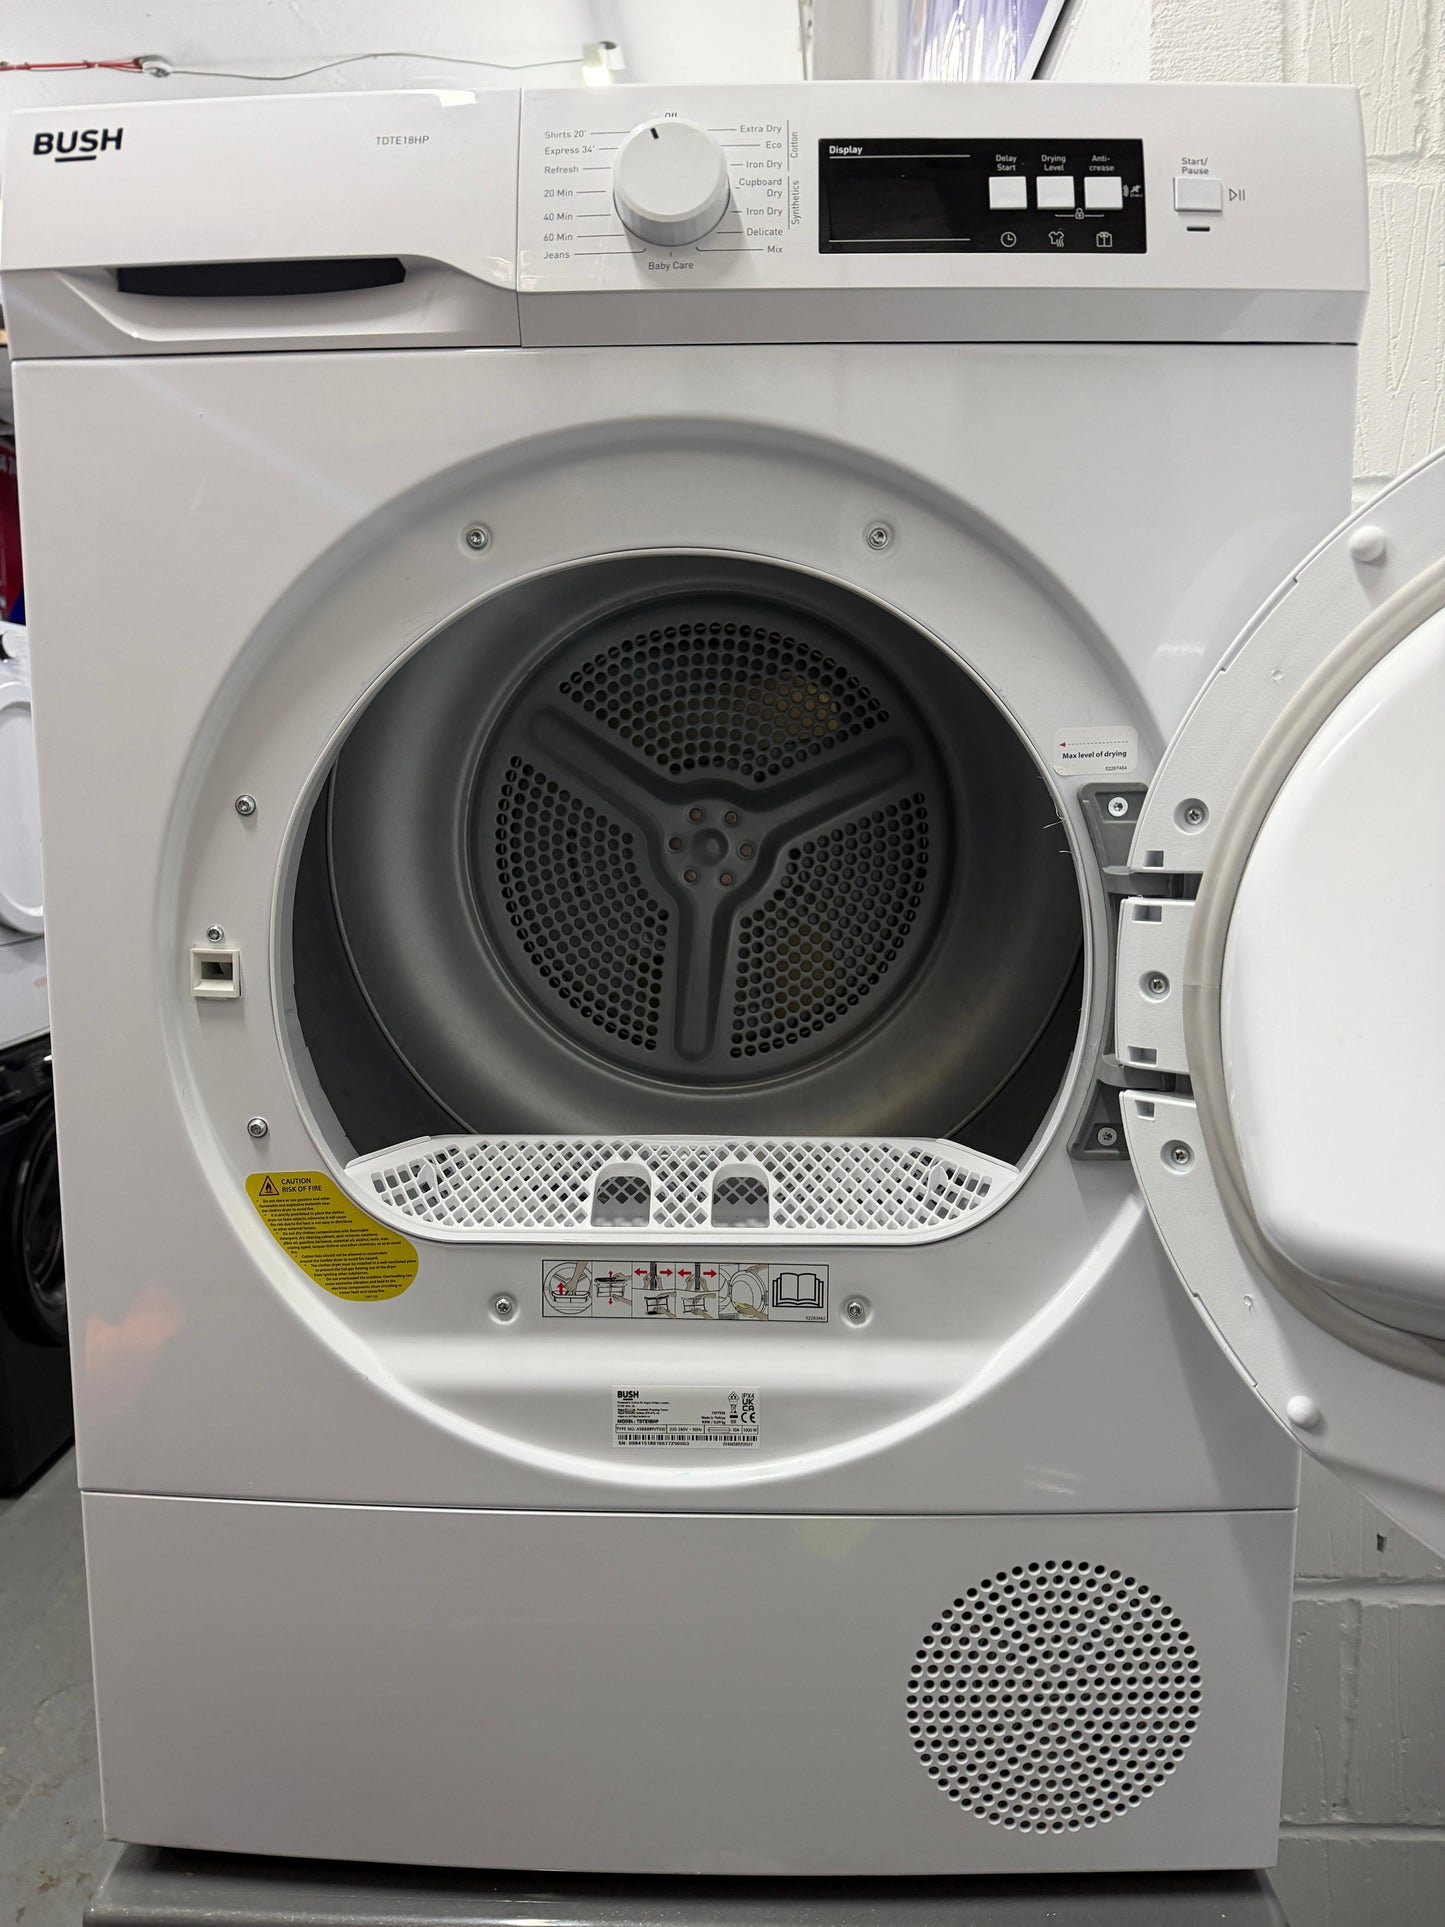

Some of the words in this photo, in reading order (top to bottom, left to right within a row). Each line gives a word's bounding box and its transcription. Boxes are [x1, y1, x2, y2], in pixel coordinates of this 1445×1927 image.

[766, 125, 782, 134] Dry
[33, 128, 124, 156] BUSH
[376, 136, 430, 145] TDTE18HP
[790, 131, 799, 158] Cotton
[545, 147, 579, 156] Express
[829, 145, 863, 155] Display
[996, 154, 1017, 162] Delay
[1041, 155, 1066, 163] Drying
[1182, 157, 1208, 166] Start/
[767, 160, 782, 169] Dry
[739, 178, 782, 187] Cupboard
[767, 189, 782, 198] Dry
[791, 180, 801, 225] Synthetics
[767, 207, 783, 216] Dry
[544, 251, 570, 259] Jeans
[648, 262, 670, 271] Baby
[673, 261, 694, 269] Care
